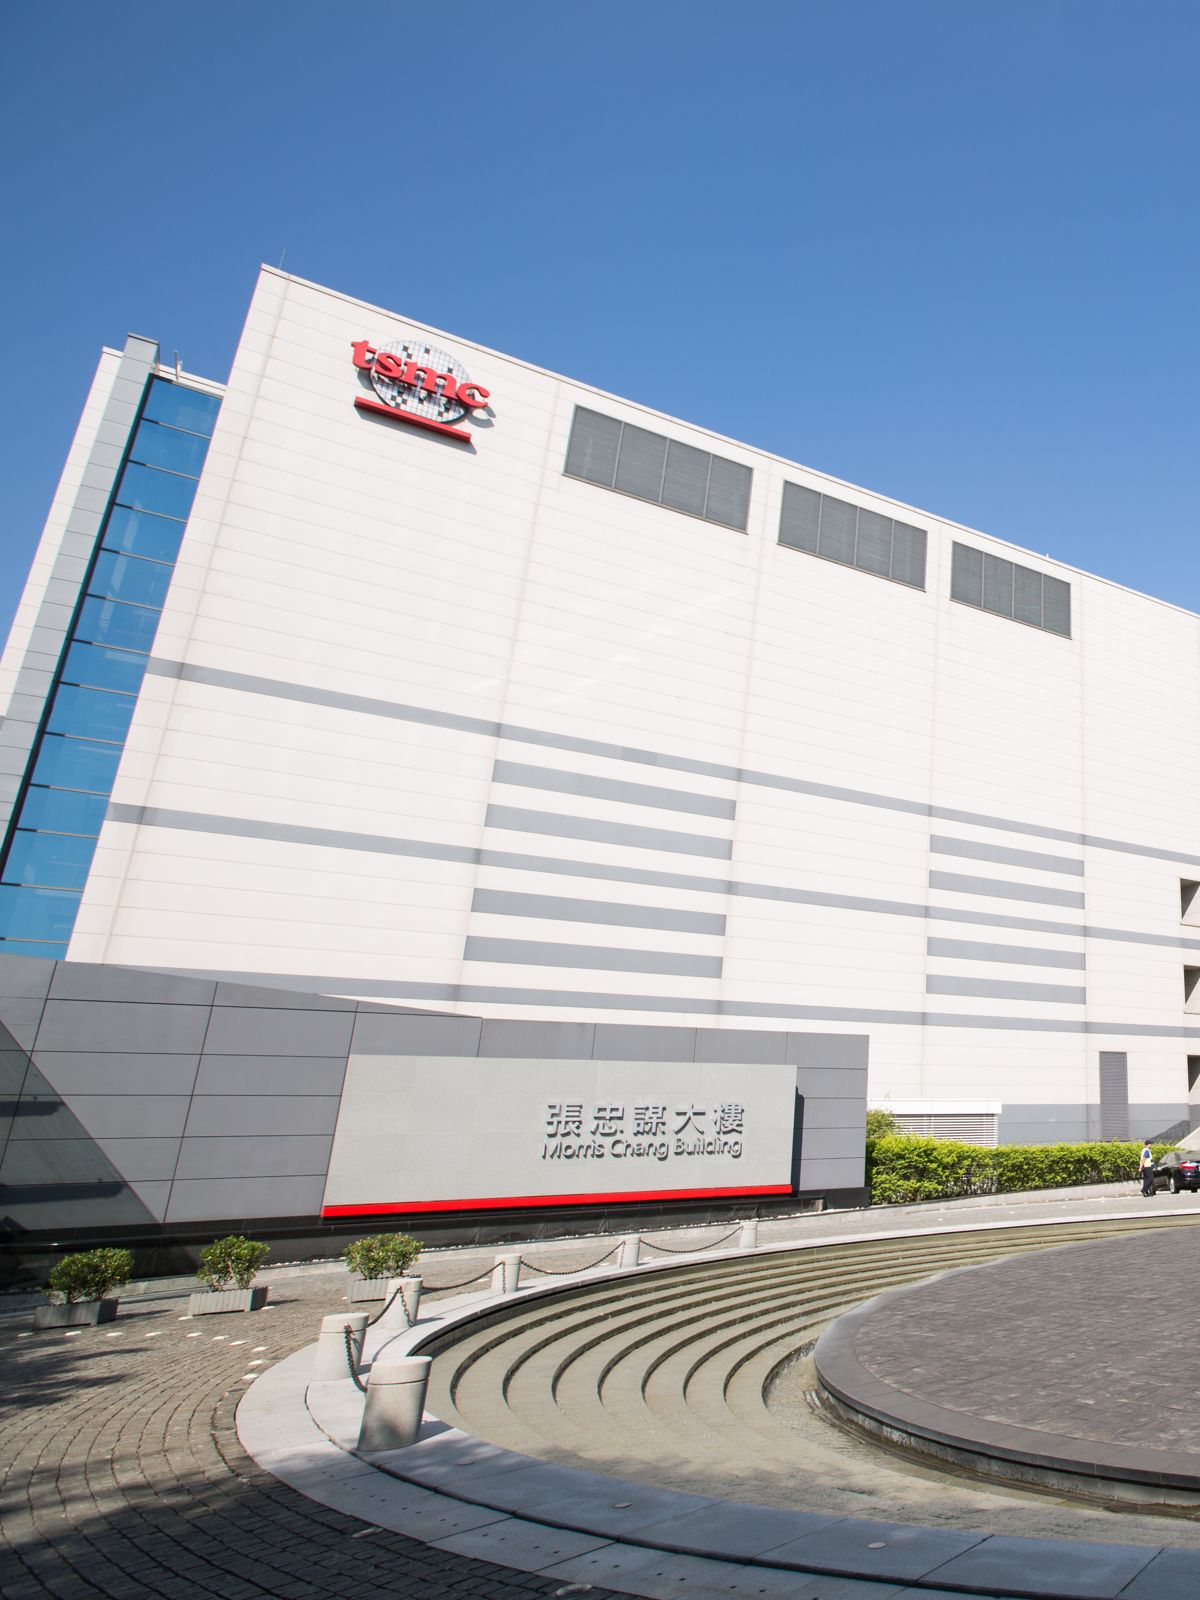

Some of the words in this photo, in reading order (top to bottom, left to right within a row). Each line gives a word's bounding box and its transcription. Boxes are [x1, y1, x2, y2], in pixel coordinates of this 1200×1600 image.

[351, 340, 490, 408] tsmc
[545, 1102, 745, 1138] 張忠謀大樓
[541, 1139, 605, 1160] Morris
[610, 1138, 669, 1161] Chang
[674, 1137, 743, 1159] Building
